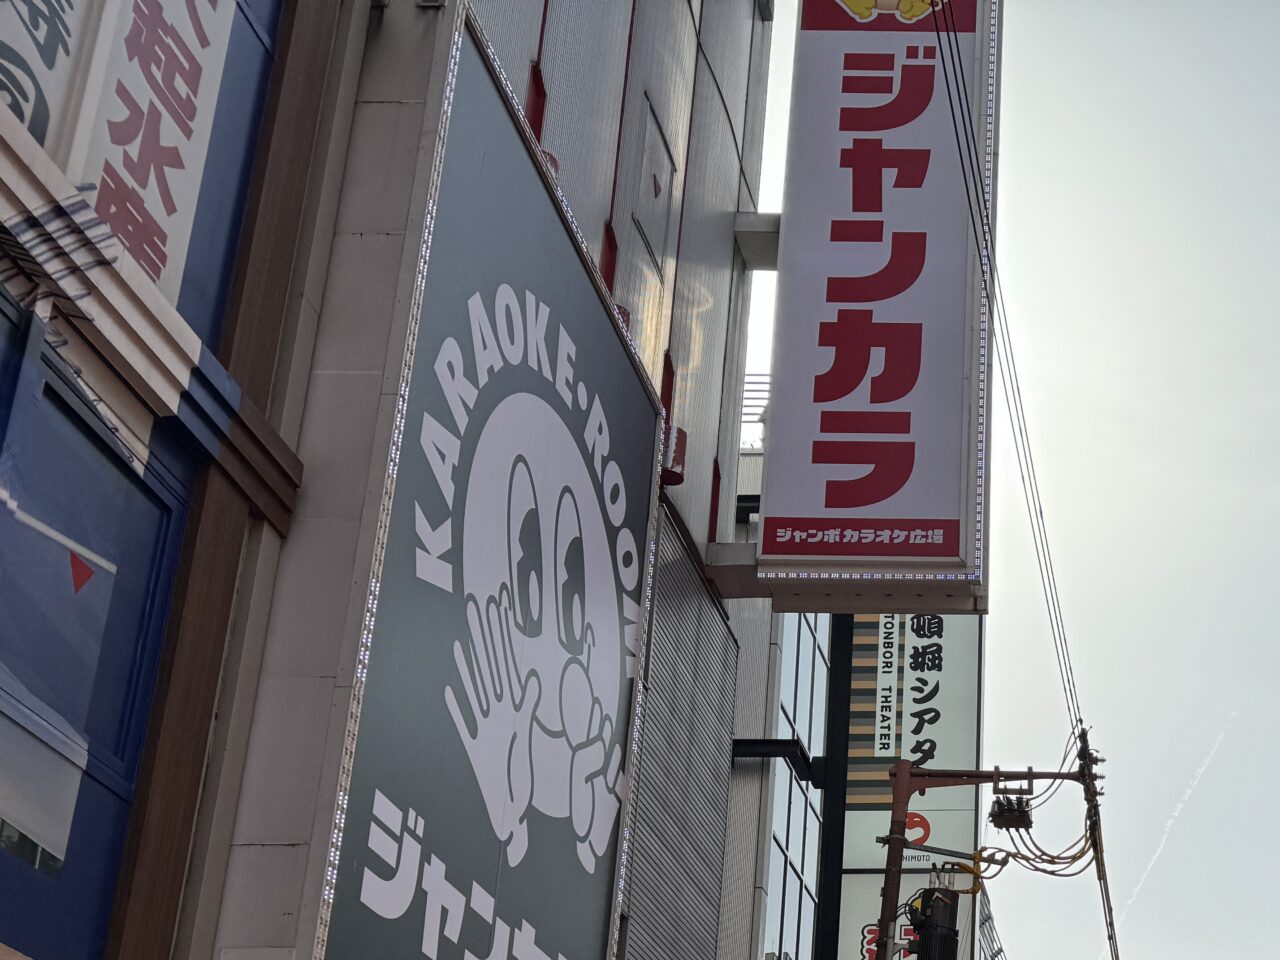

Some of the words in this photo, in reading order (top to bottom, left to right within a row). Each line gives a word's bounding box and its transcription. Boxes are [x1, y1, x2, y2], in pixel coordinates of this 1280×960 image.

[811, 45, 937, 509] ジャンカラ
[413, 281, 577, 593] KARAOKE
[776, 527, 945, 545] ジャンボカラオケ広場
[878, 686, 891, 751] THEATER
[909, 614, 944, 796] 頓堀シアタ
